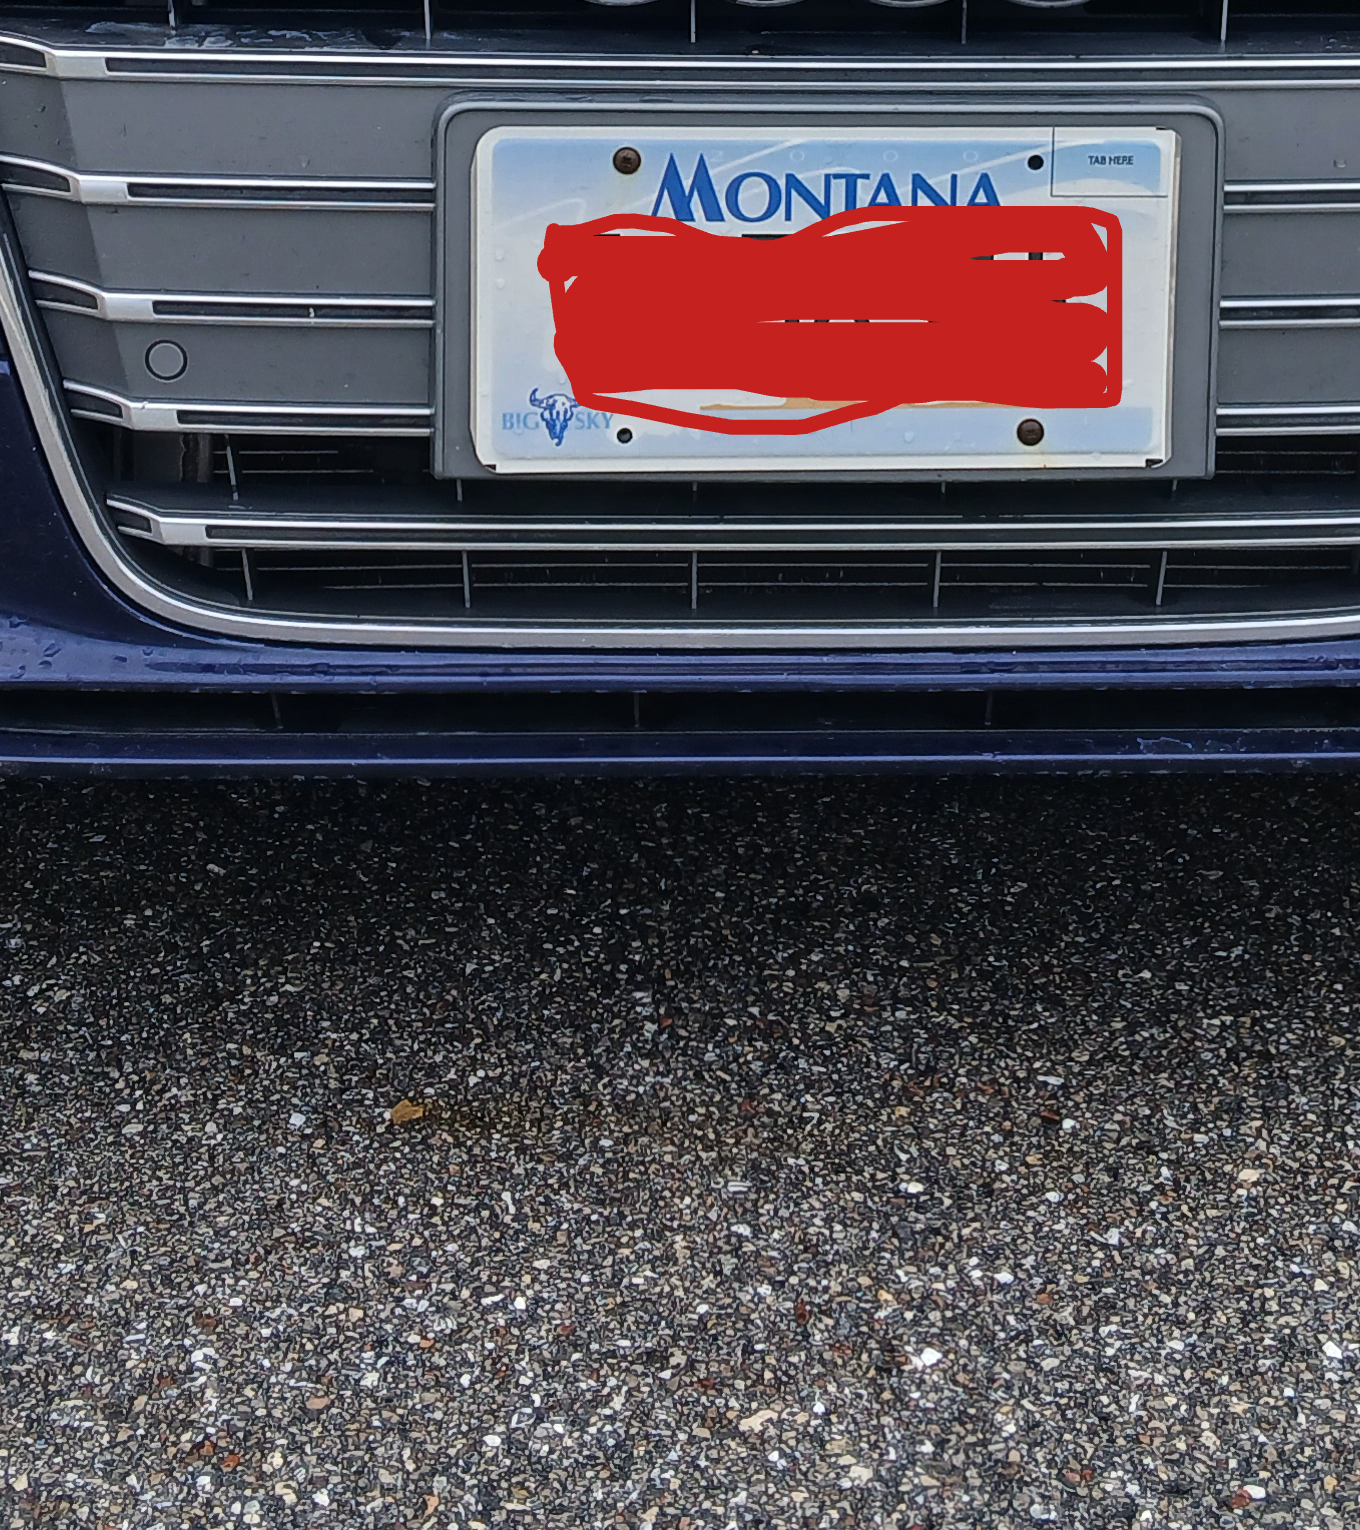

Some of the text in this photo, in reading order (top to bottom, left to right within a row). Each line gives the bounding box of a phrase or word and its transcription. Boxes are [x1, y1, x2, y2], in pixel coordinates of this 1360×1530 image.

[1088, 155, 1134, 166] TAB HERE
[651, 152, 1002, 222] MONTANA
[502, 411, 614, 431] BIG SKY
